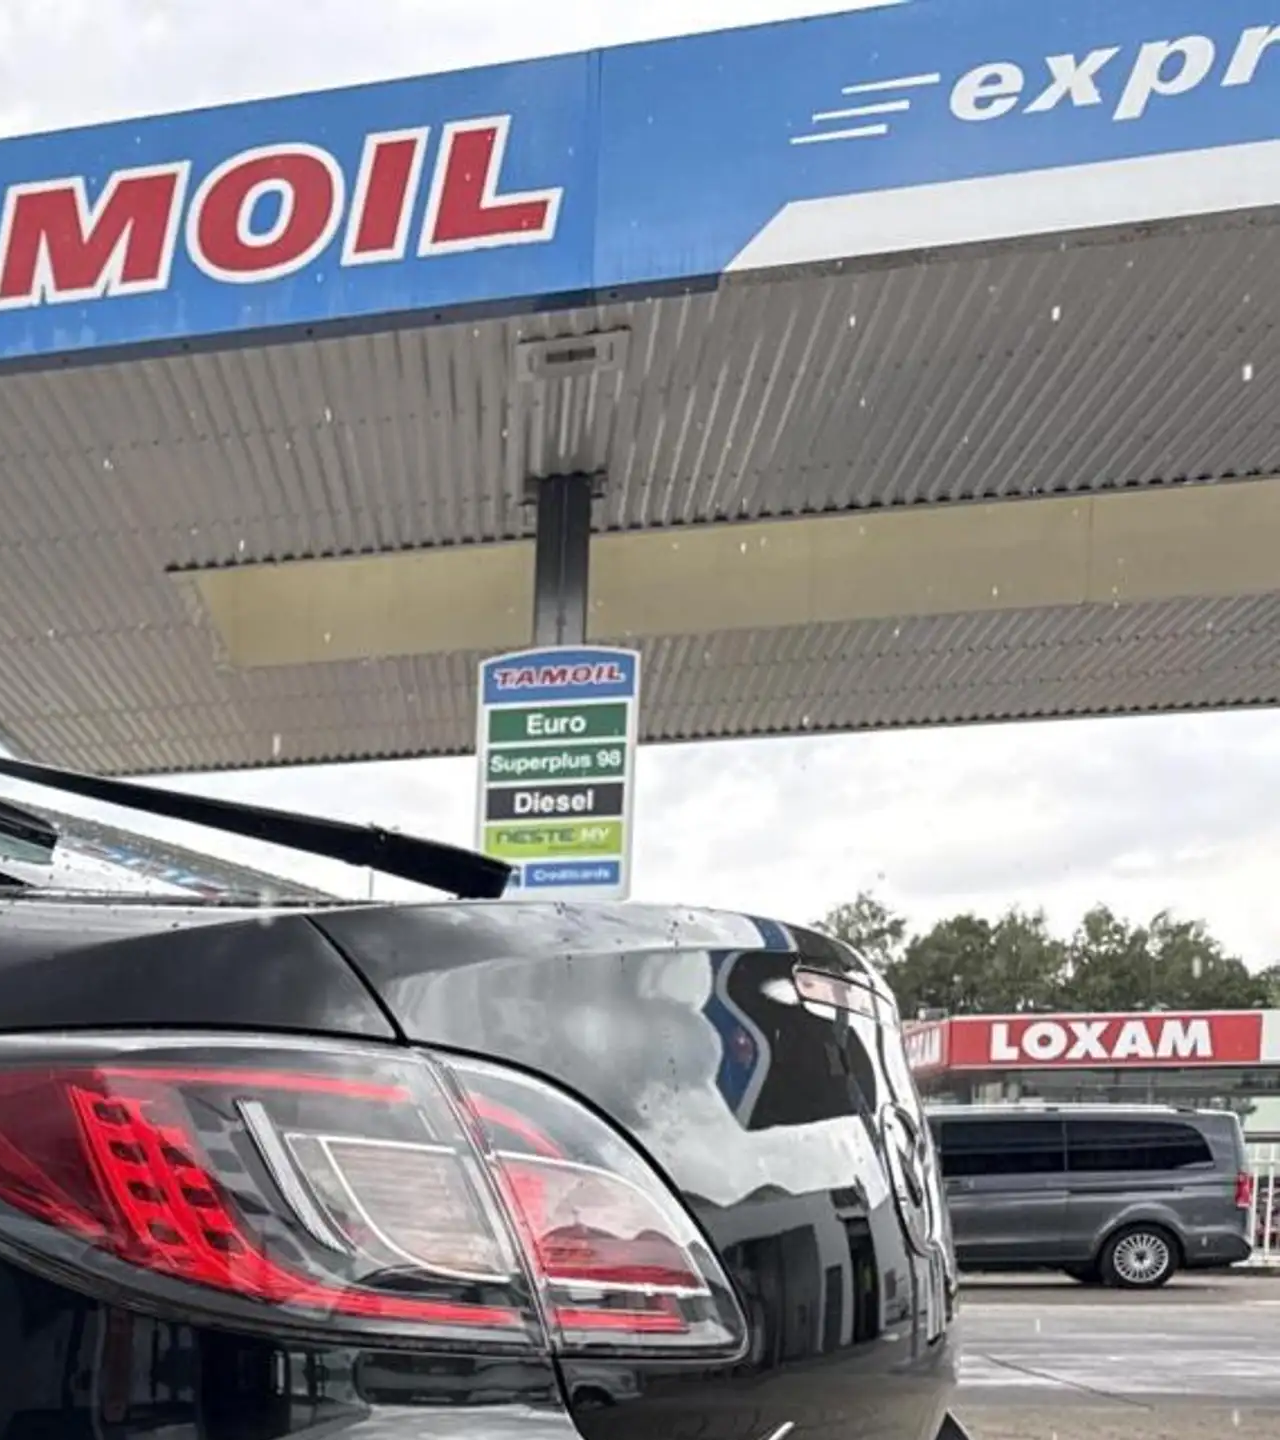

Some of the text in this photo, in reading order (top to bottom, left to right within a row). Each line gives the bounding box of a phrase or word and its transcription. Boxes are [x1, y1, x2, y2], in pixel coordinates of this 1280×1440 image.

[494, 662, 626, 690] TAMOIL
[526, 714, 587, 735] Euro
[490, 749, 622, 774] Superplus 98
[514, 789, 594, 814] Diesel
[991, 1019, 1212, 1061] LOXAM
